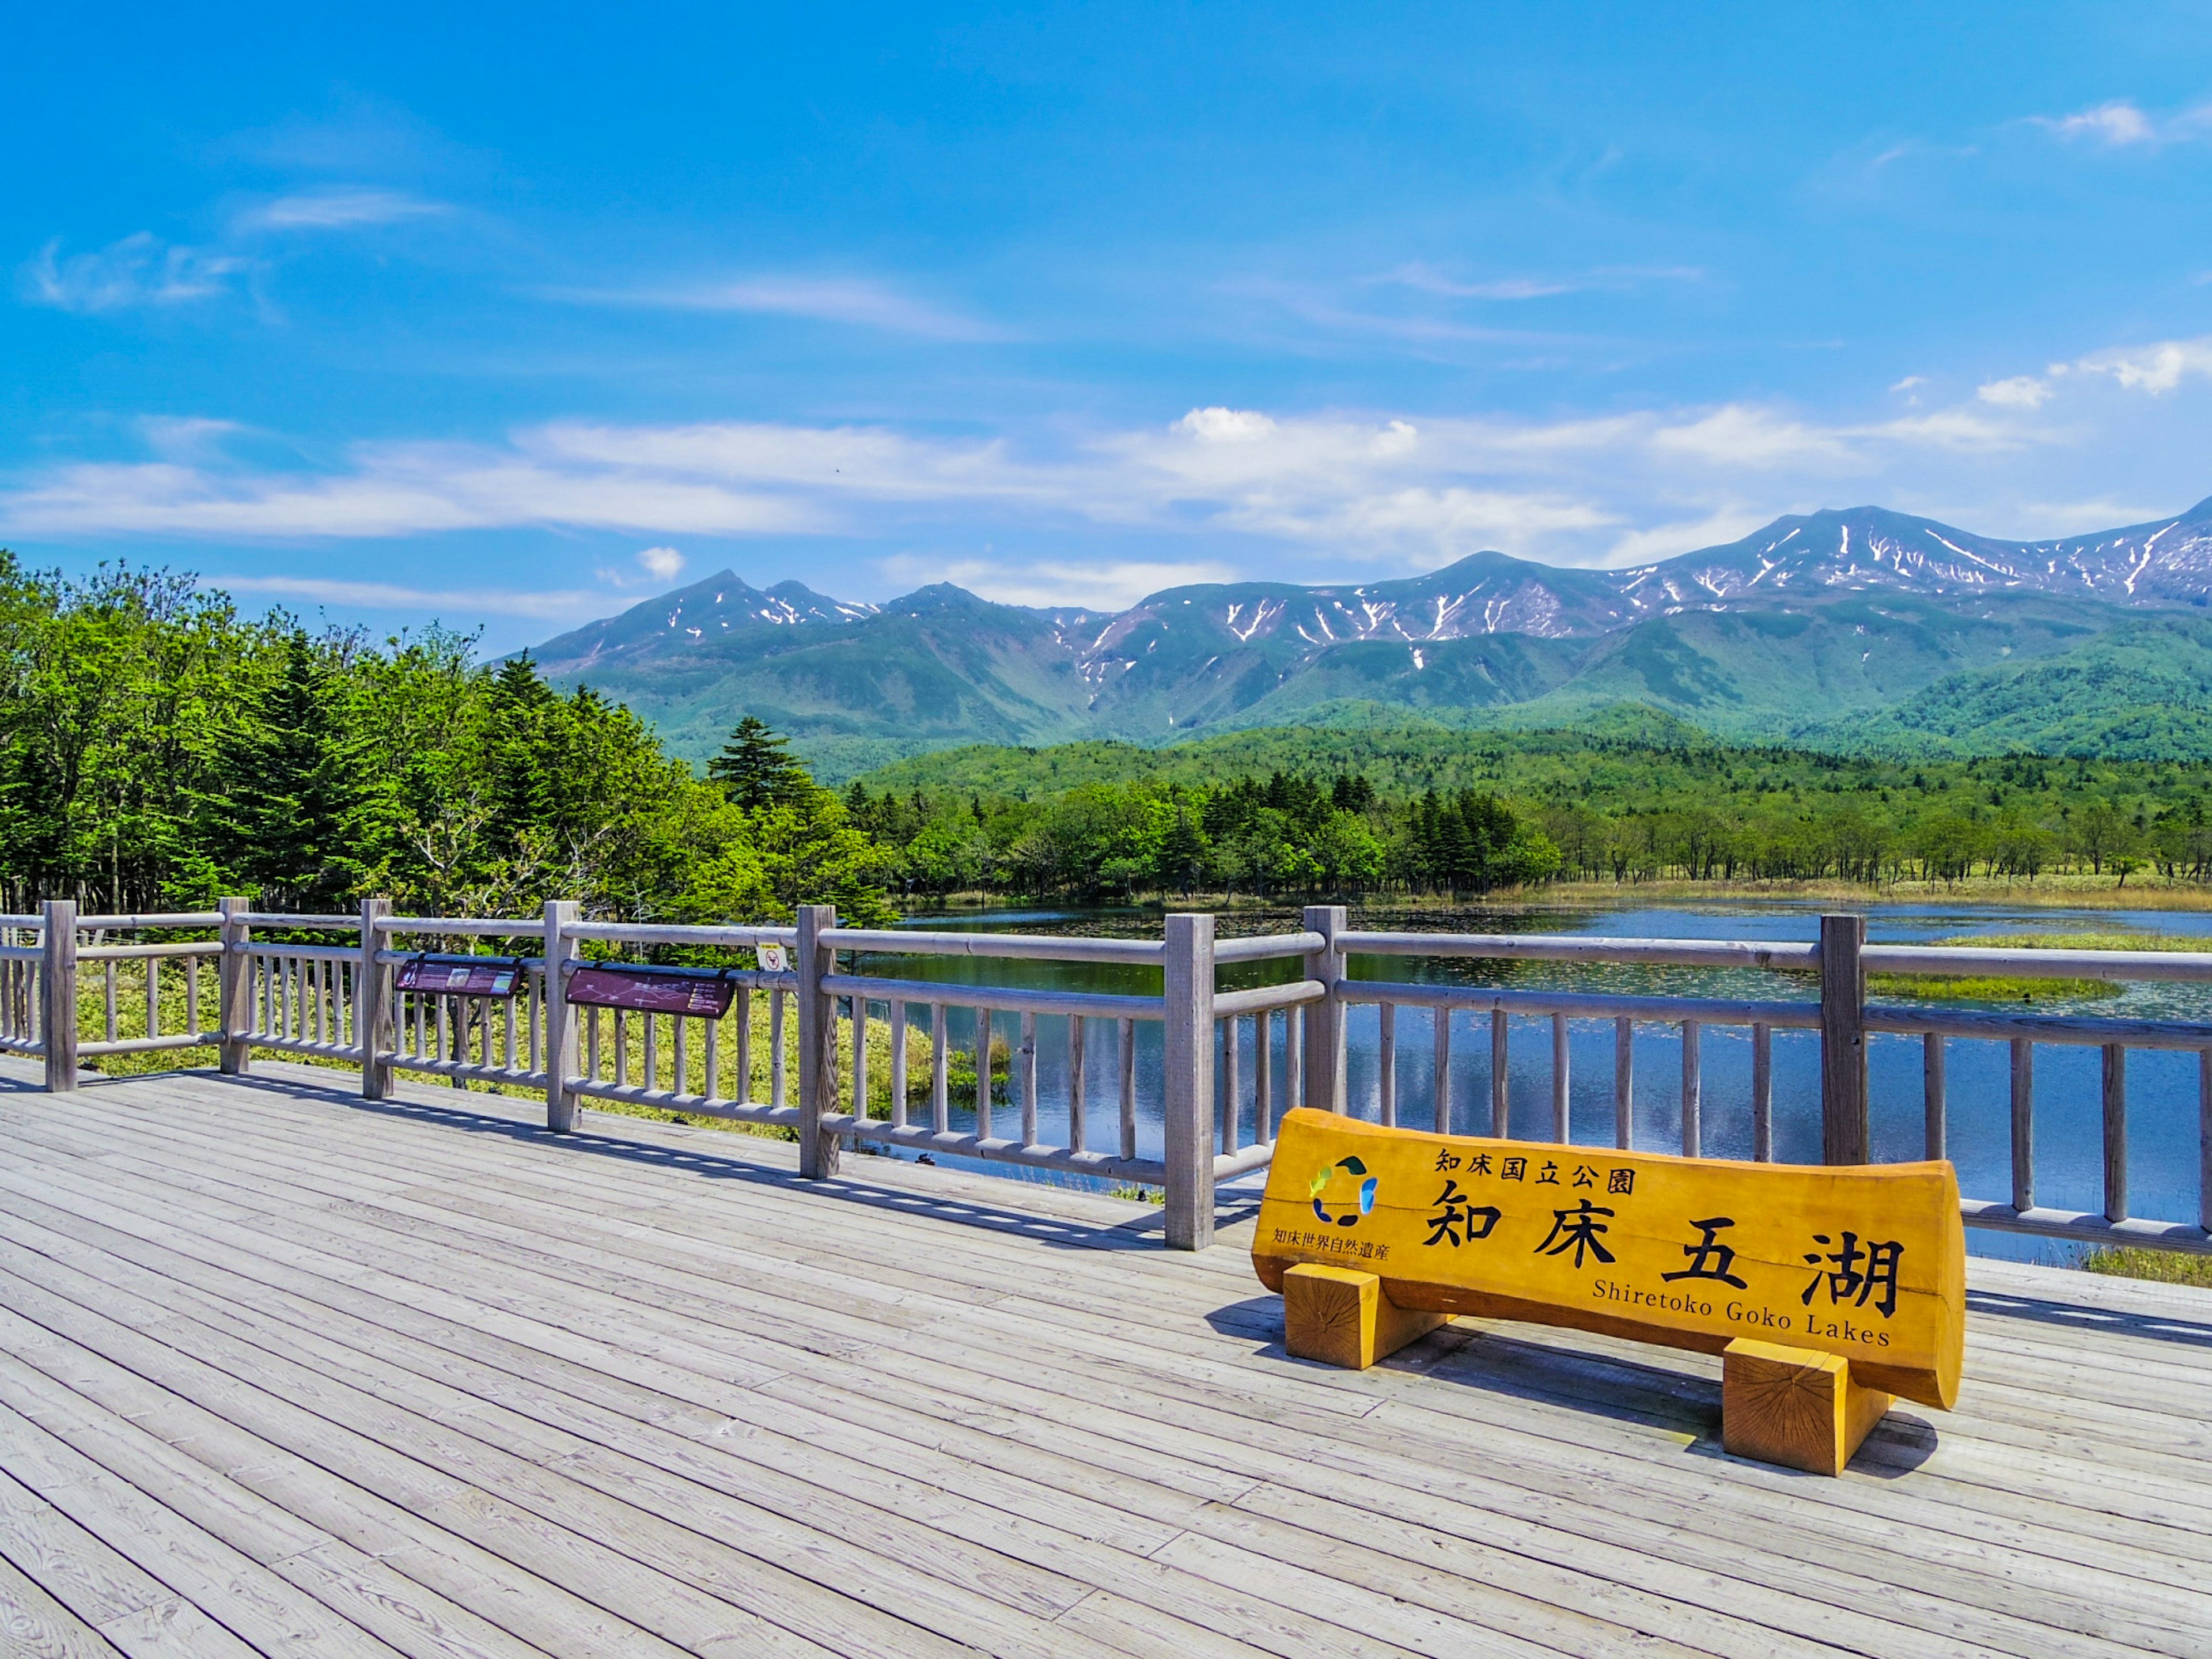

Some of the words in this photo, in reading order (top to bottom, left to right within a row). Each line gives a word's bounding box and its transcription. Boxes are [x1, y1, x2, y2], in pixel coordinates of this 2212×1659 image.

[1434, 1148, 1636, 1195] 知床国立公園
[1272, 1228, 1391, 1261] 知床世界自然遺産
[1422, 1180, 1905, 1319] 知床五湖
[1592, 1279, 1712, 1316] Shiretoko
[1726, 1301, 1791, 1330] Goko
[1806, 1315, 1890, 1347] Lakes
